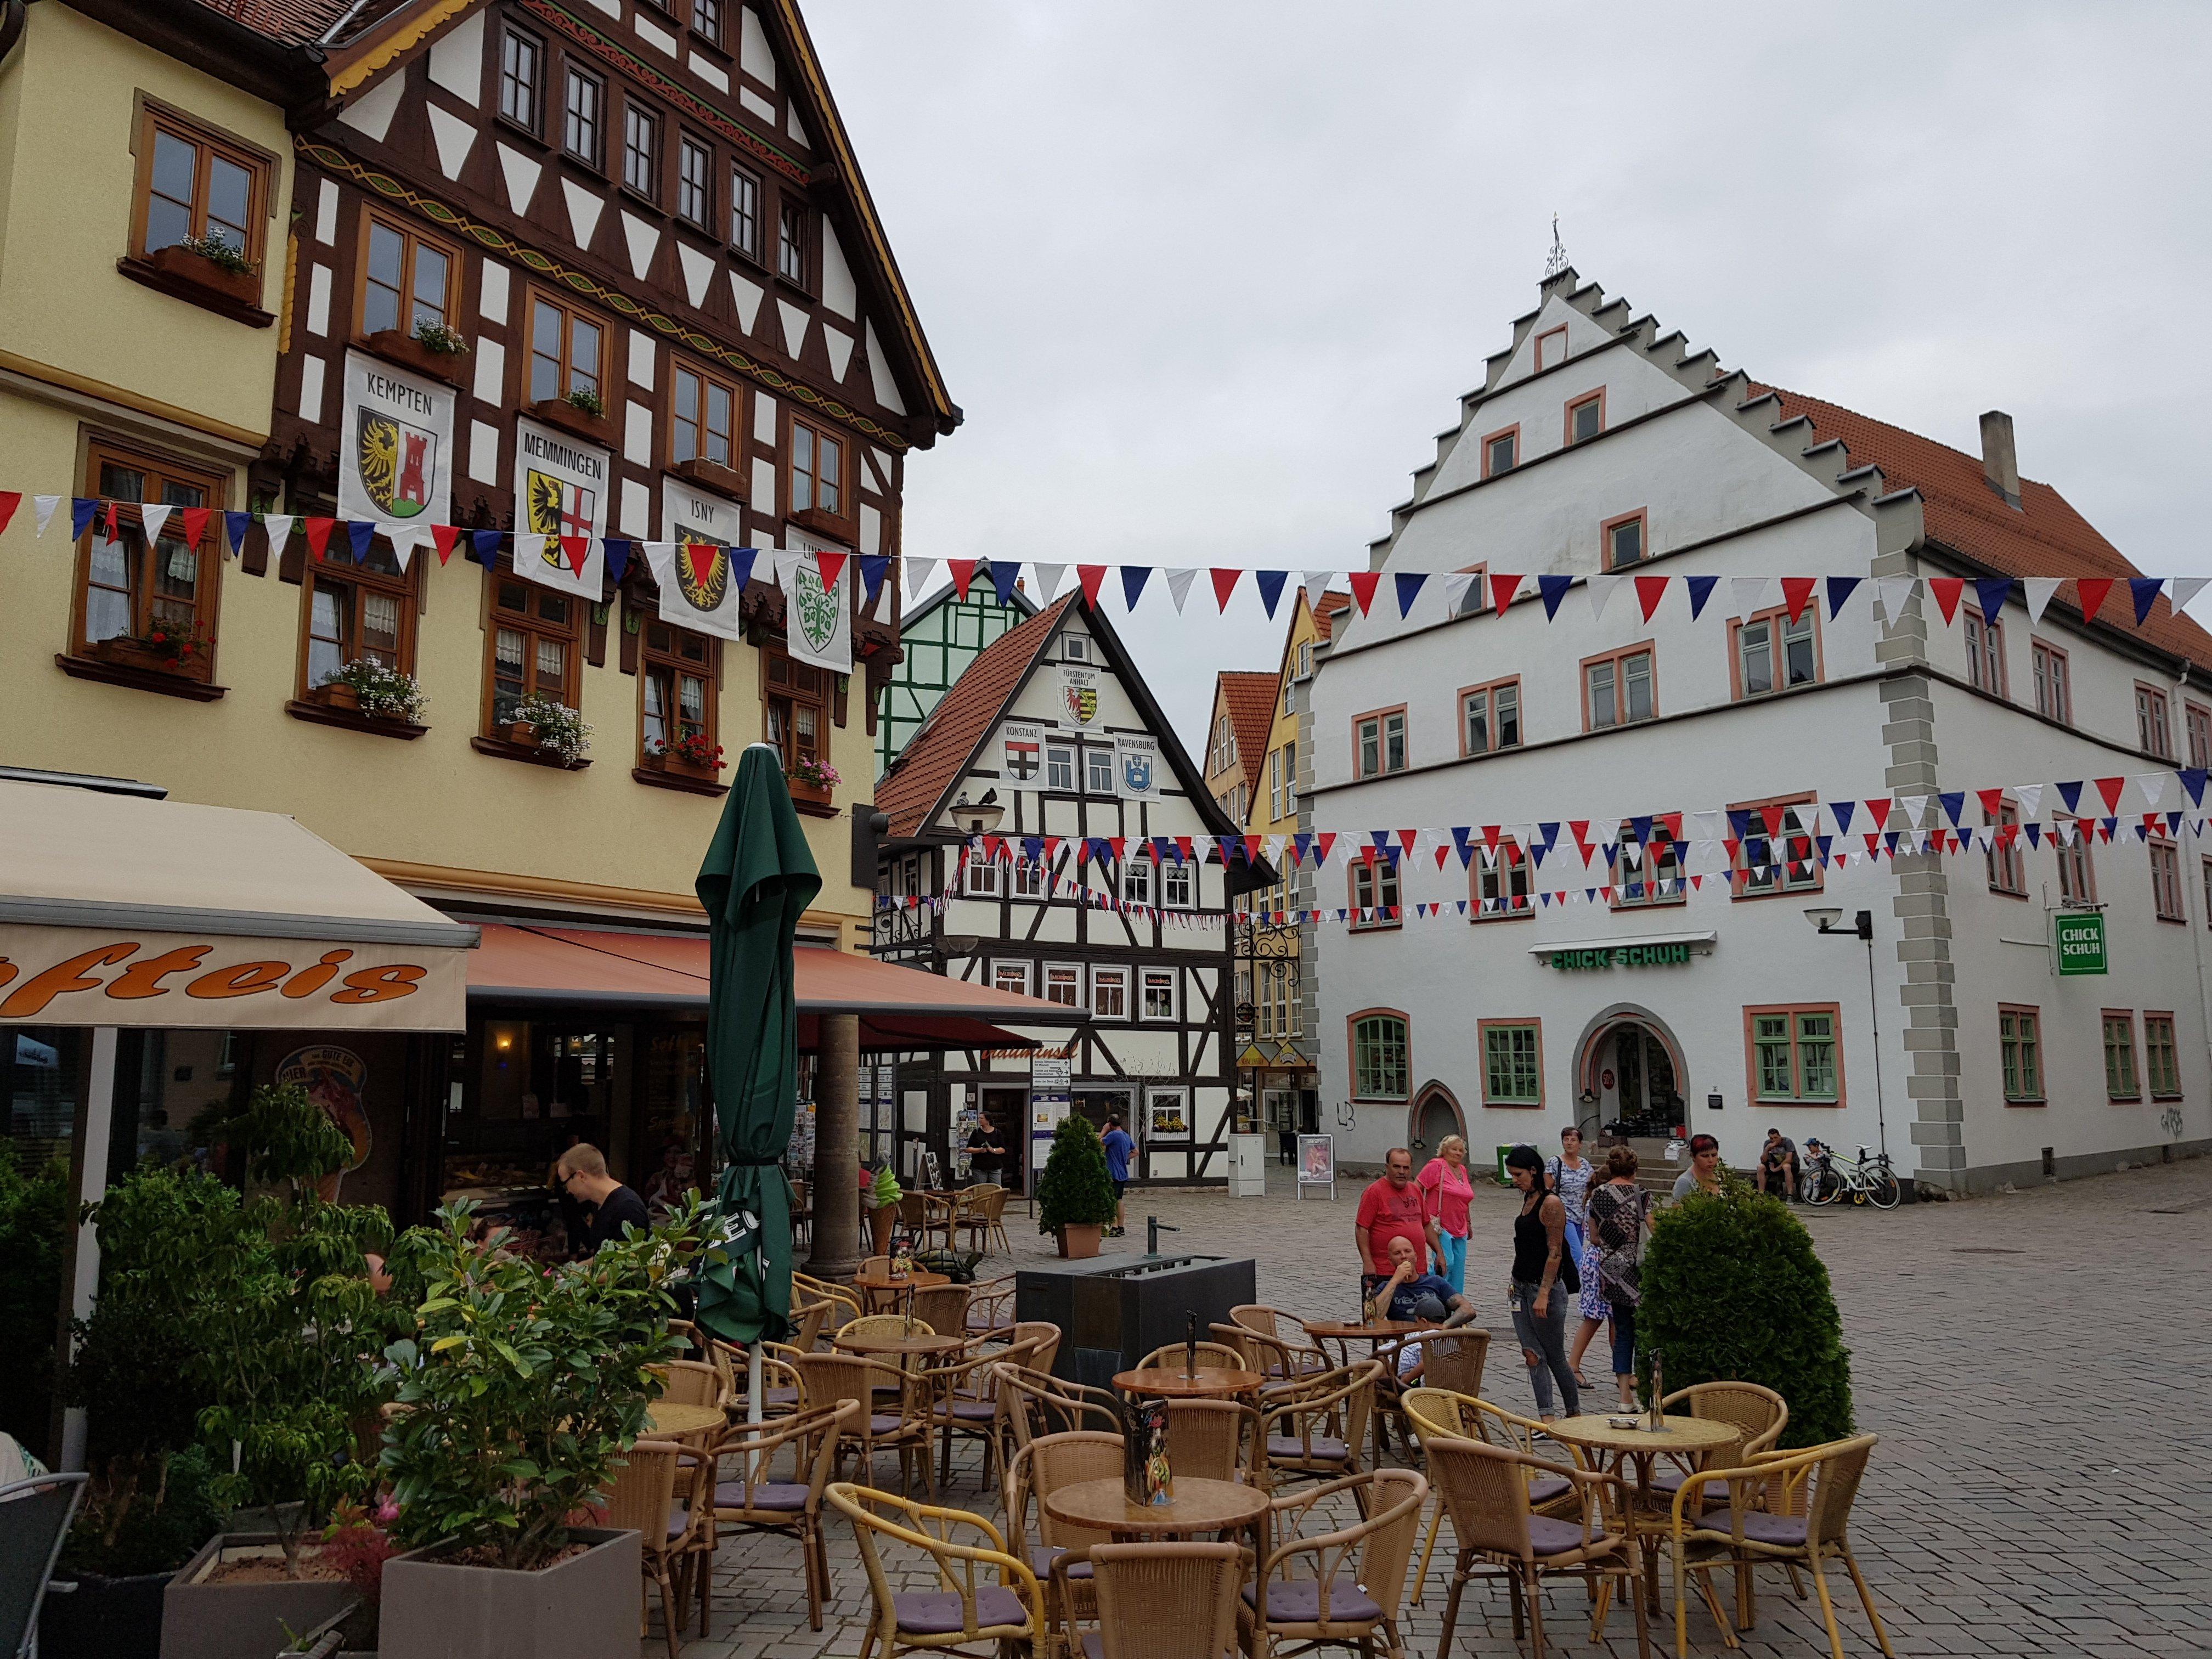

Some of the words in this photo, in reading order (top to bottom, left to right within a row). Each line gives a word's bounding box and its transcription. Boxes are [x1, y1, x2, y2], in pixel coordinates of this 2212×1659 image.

[367, 372, 432, 416] KEMPTEN
[524, 432, 602, 479] MEMMINGEN
[691, 499, 714, 523] ISNY
[1063, 669, 1095, 680] FÜRSTENTUM
[1006, 726, 1037, 738] KONSTANZ
[1118, 738, 1155, 751] RAVENSBURG
[2062, 928, 2099, 941] CHICK
[1551, 950, 1611, 969] CHICK
[1615, 944, 1689, 964] SCHUH
[2063, 943, 2100, 955] SCHUH
[0, 942, 427, 1018] fteis
